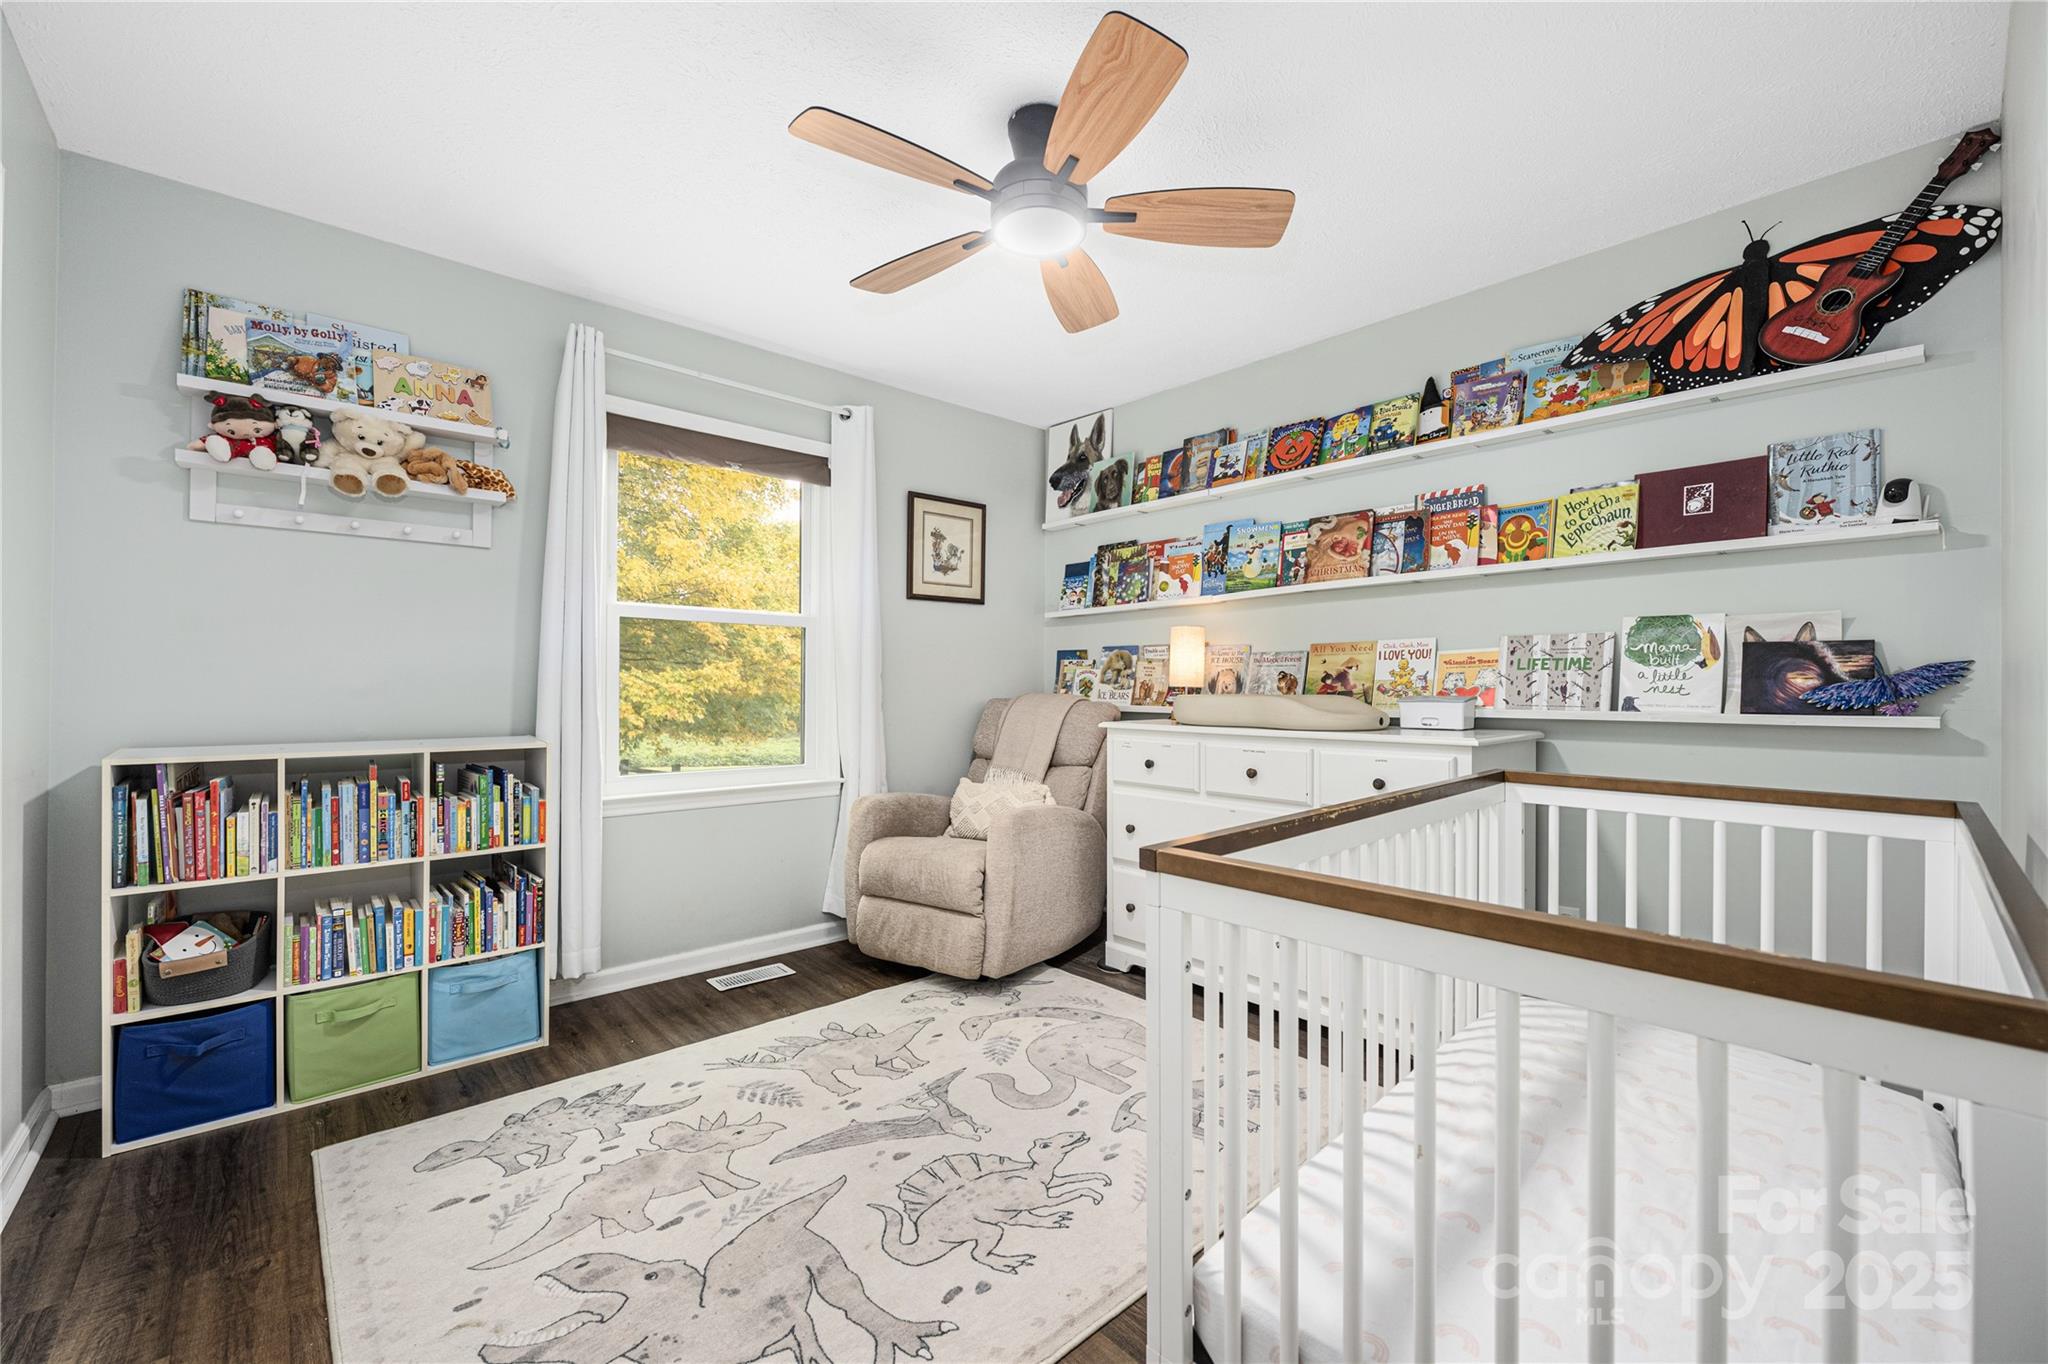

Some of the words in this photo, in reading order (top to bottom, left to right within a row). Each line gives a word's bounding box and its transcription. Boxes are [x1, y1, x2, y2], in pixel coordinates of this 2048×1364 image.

[250, 319, 292, 337] Molly,
[293, 325, 308, 340] by
[310, 328, 349, 343] Golly!
[1518, 344, 1562, 361] Scarecrow's
[393, 376, 475, 408] ANNA
[1786, 449, 1824, 466] Little
[1827, 443, 1859, 460] Red
[1800, 461, 1850, 478] Ruthie
[1424, 496, 1480, 513] NGERBREAD
[1499, 506, 1534, 515] ANKSGIVING
[1564, 497, 1590, 516] How
[1564, 519, 1577, 530] to
[1579, 494, 1616, 521] Catch
[1615, 495, 1620, 504] a
[1236, 525, 1274, 535] SNOWMEN
[1560, 506, 1632, 548] Leprechaun
[1312, 646, 1326, 654] All
[1329, 645, 1346, 653] You
[1351, 644, 1374, 652] Need
[1378, 650, 1382, 660] I
[1383, 649, 1405, 660] LOVE
[1407, 648, 1432, 660] YOU!
[1629, 641, 1697, 654] Mama
[1516, 657, 1593, 671] LIFETIME
[1649, 653, 1681, 666] built
[1637, 671, 1649, 680] a
[1649, 668, 1694, 685] little
[1643, 684, 1691, 696] nest
